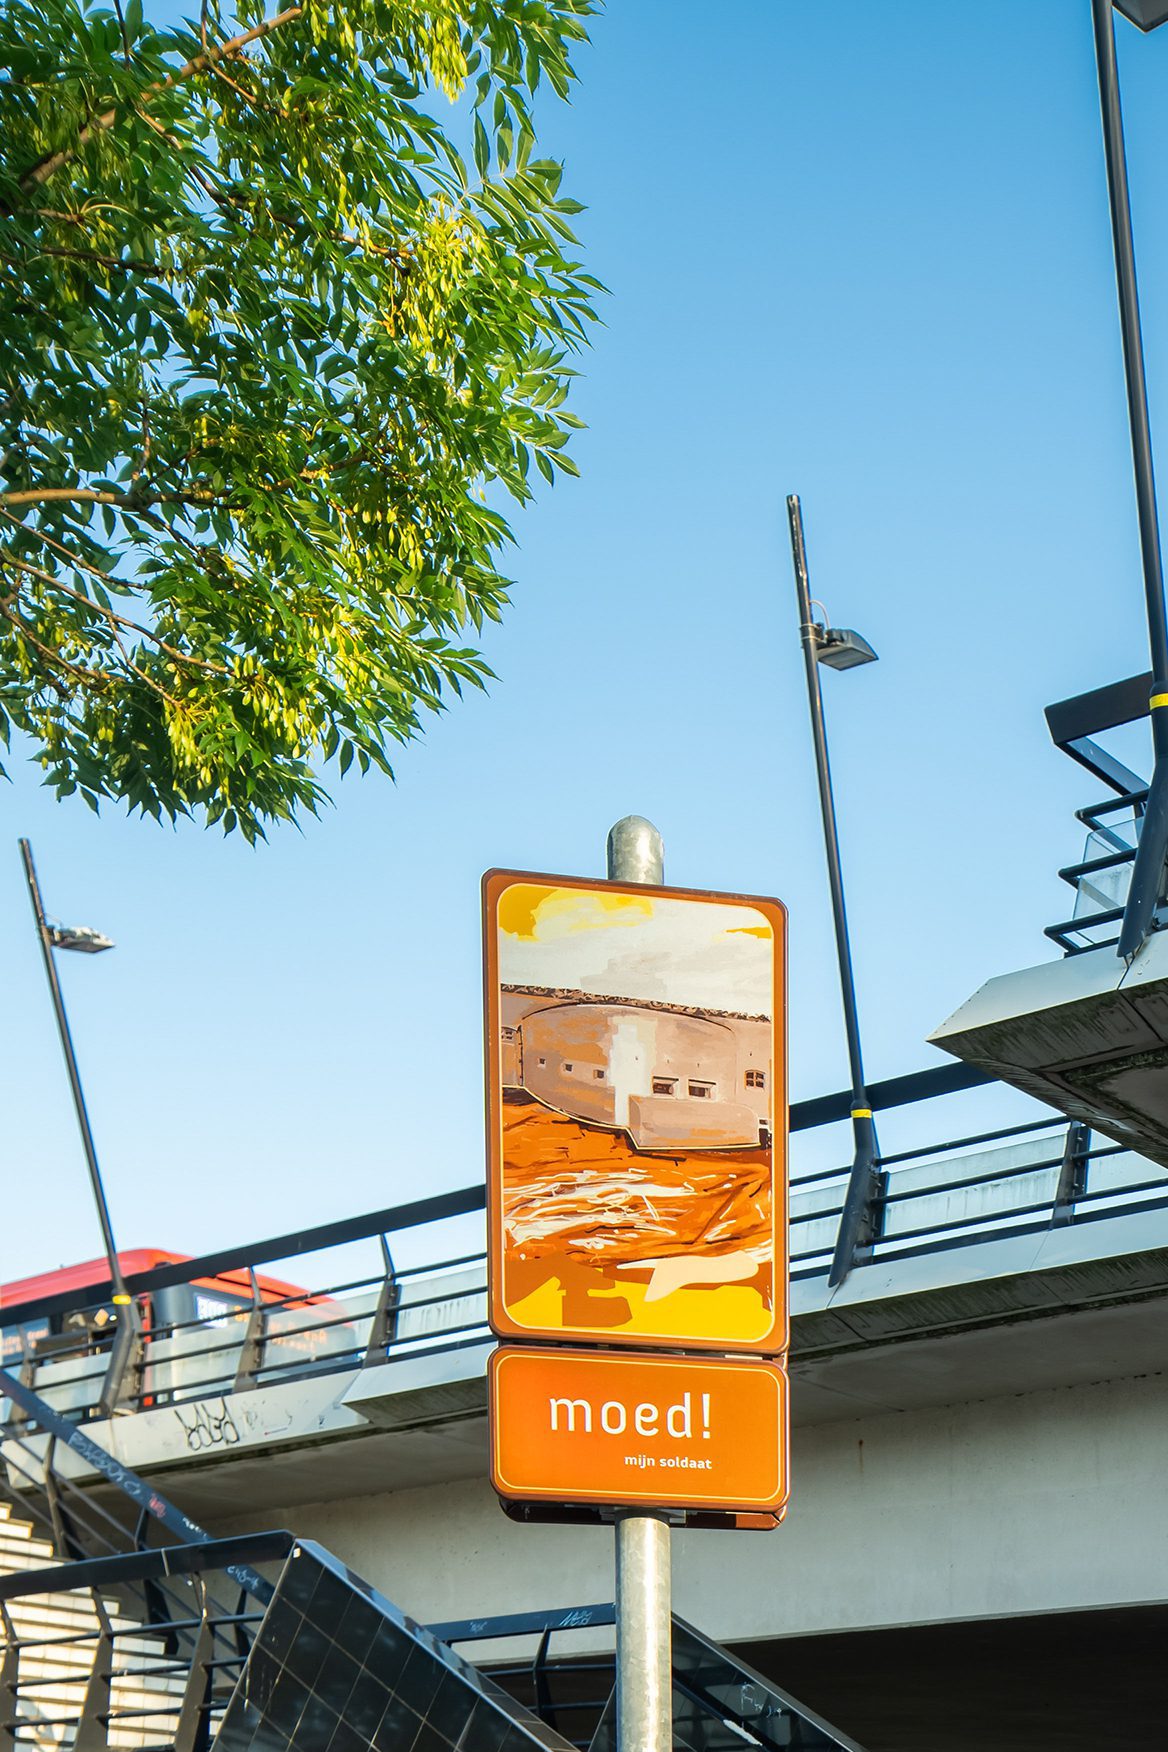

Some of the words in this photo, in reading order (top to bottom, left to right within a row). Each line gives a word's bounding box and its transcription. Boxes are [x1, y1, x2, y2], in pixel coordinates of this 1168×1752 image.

[549, 1392, 711, 1439] moed!
[624, 1454, 655, 1469] mijn
[659, 1456, 712, 1469] soldaat
